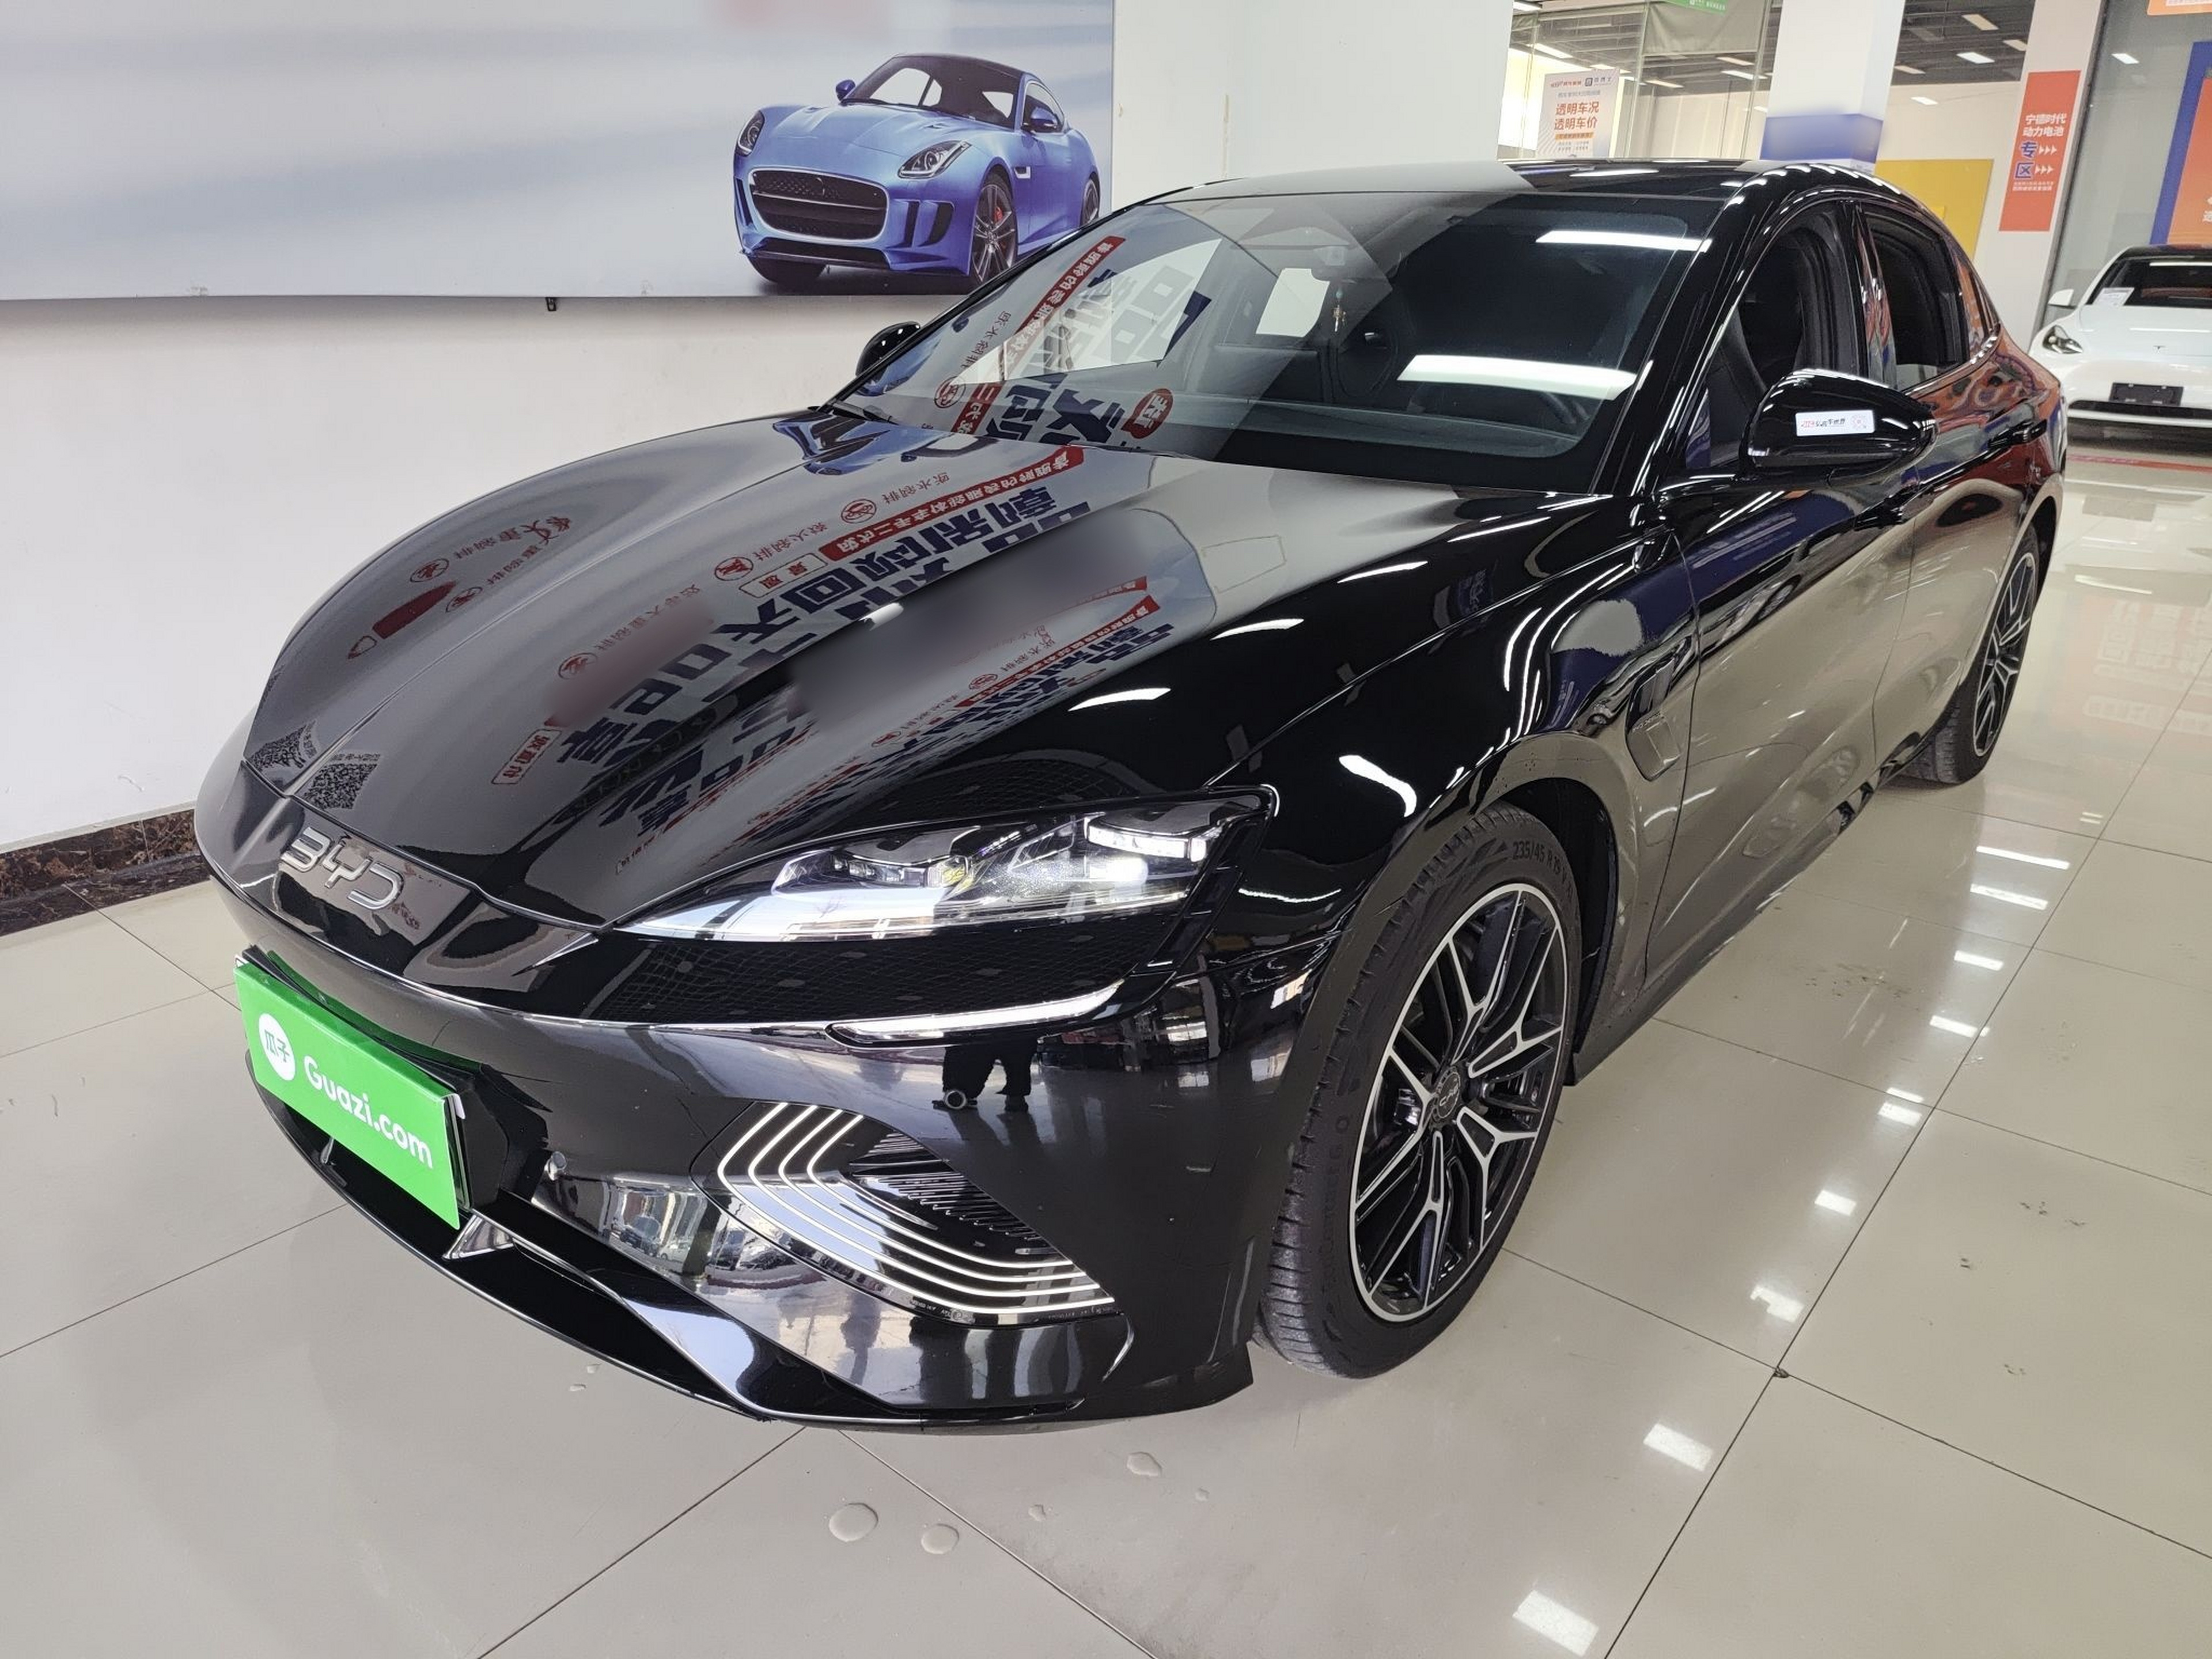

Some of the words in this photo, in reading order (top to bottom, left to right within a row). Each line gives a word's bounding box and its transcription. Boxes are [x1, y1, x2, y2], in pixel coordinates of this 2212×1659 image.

[1556, 101, 1600, 116] 透明车况
[1554, 116, 1598, 130] 透明车价
[2022, 126, 2065, 138] 动力电池
[281, 826, 404, 910] BYD
[263, 1029, 290, 1063] 瓜子
[303, 1055, 434, 1169] Guazi.com
